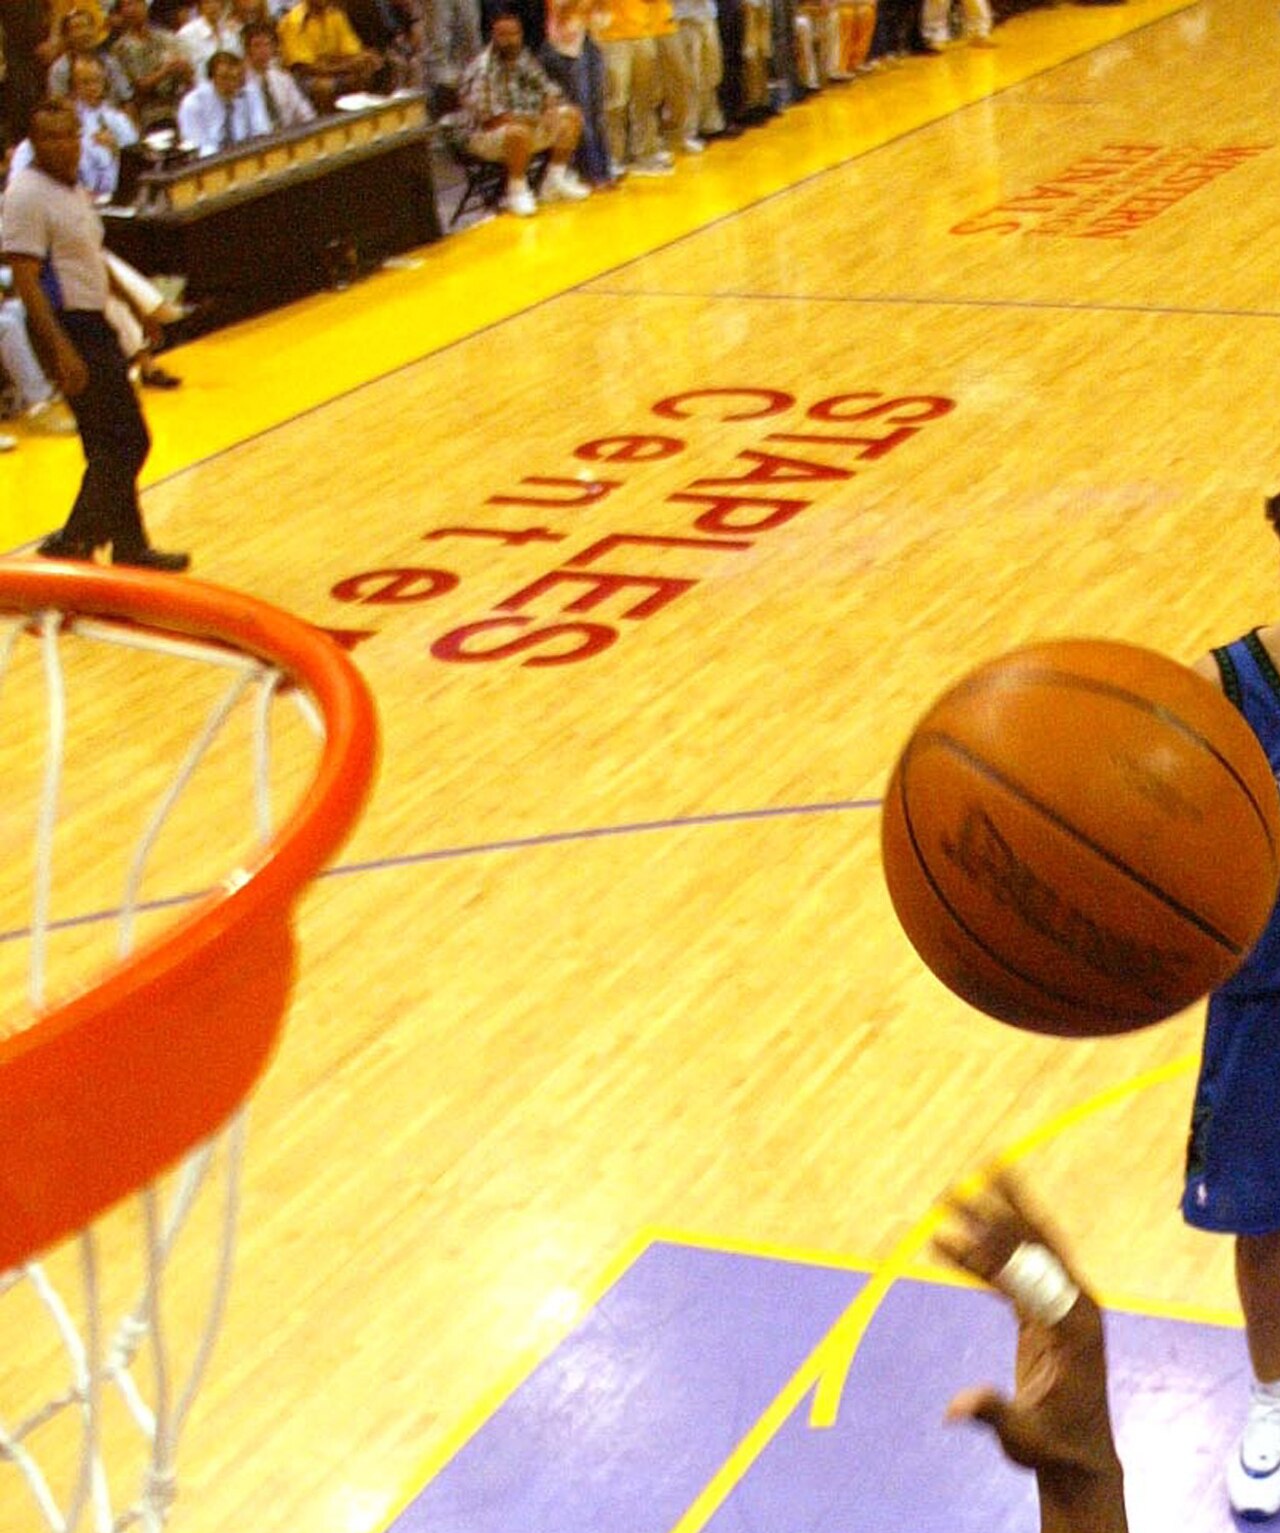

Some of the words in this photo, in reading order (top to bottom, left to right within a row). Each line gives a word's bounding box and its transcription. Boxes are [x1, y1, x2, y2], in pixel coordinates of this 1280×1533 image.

[948, 144, 1164, 236] FINALS
[1069, 144, 1275, 239] WESTERN
[429, 391, 957, 668] STAPLES
